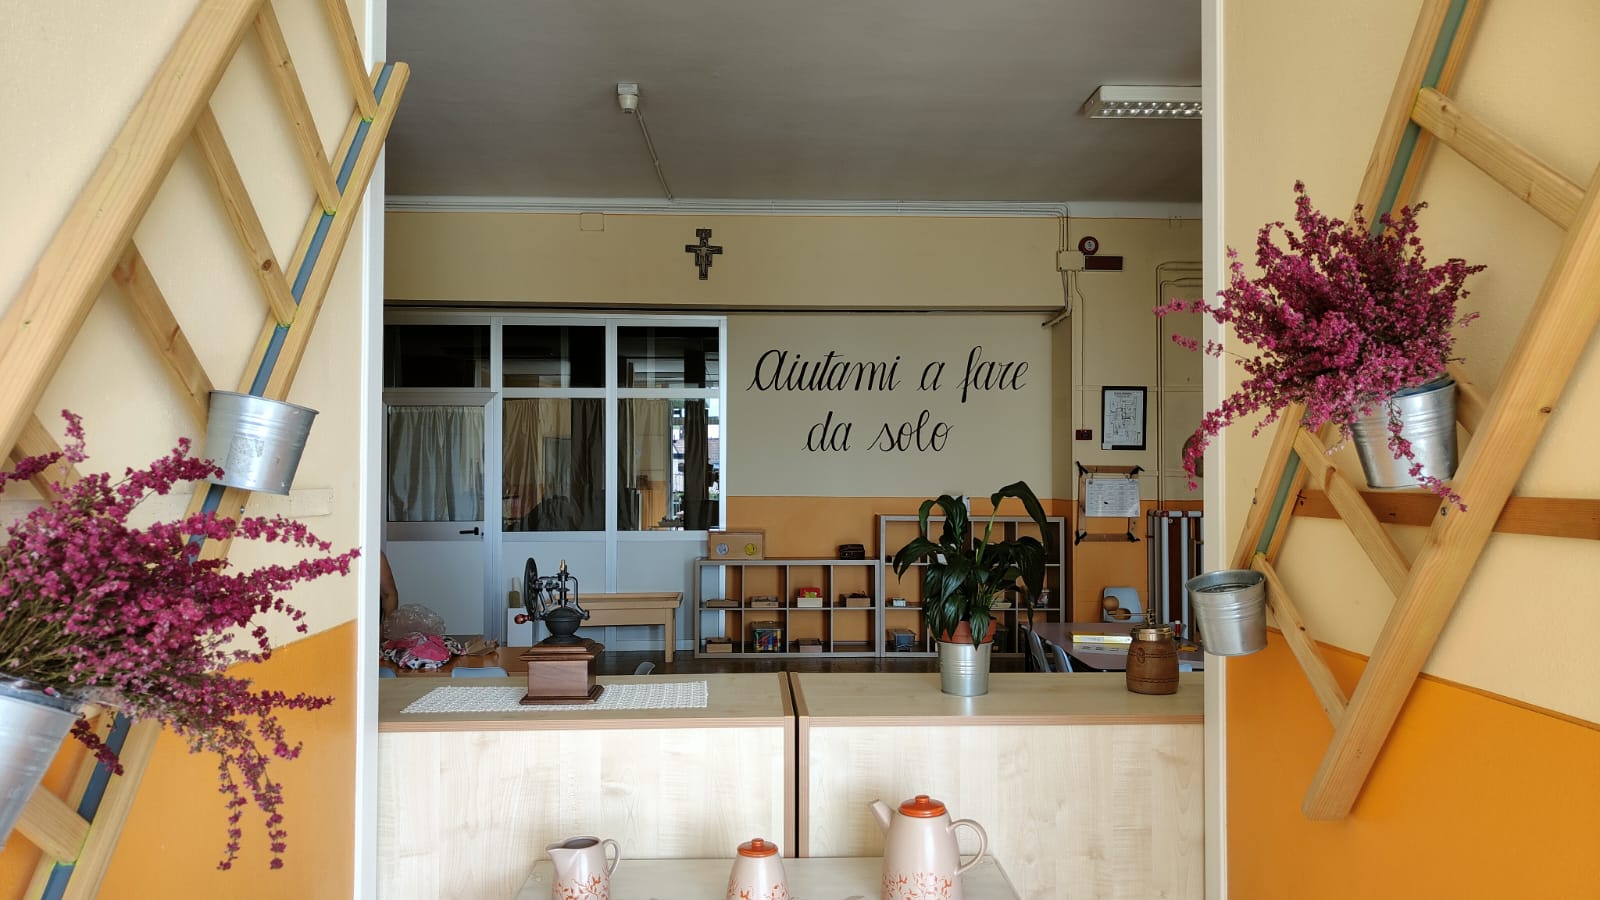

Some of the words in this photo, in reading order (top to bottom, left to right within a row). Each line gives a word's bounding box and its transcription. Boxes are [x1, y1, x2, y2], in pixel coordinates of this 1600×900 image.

[916, 360, 945, 391] a
[955, 345, 1030, 404] fare
[801, 411, 854, 452] da
[866, 409, 954, 452] solo
